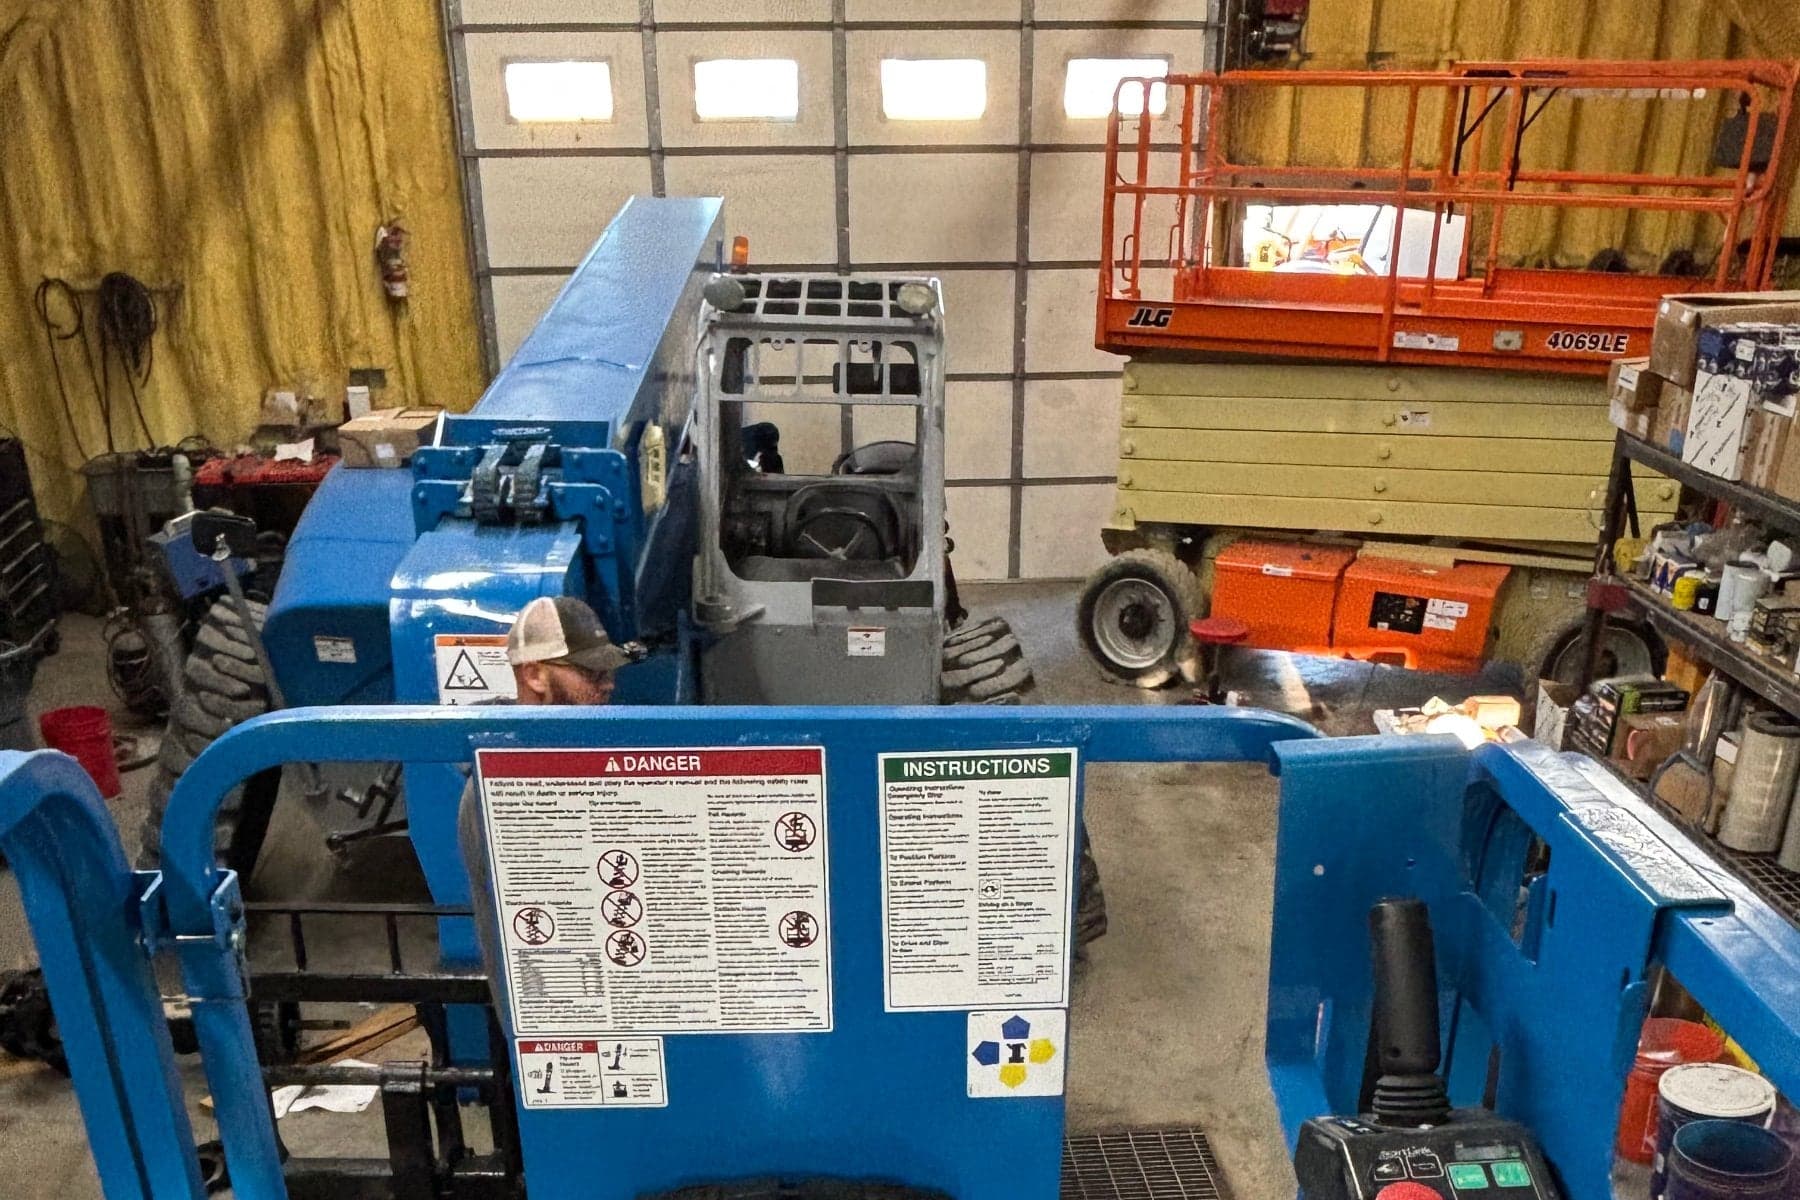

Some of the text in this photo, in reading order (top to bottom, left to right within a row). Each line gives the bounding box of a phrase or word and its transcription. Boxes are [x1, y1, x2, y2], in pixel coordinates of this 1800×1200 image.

[1127, 308, 1172, 328] JLG
[1547, 331, 1628, 353] 4069LE
[624, 755, 701, 772] DANGER
[903, 758, 1051, 777] INSTRUCTIONS
[544, 1041, 583, 1052] DANGER
